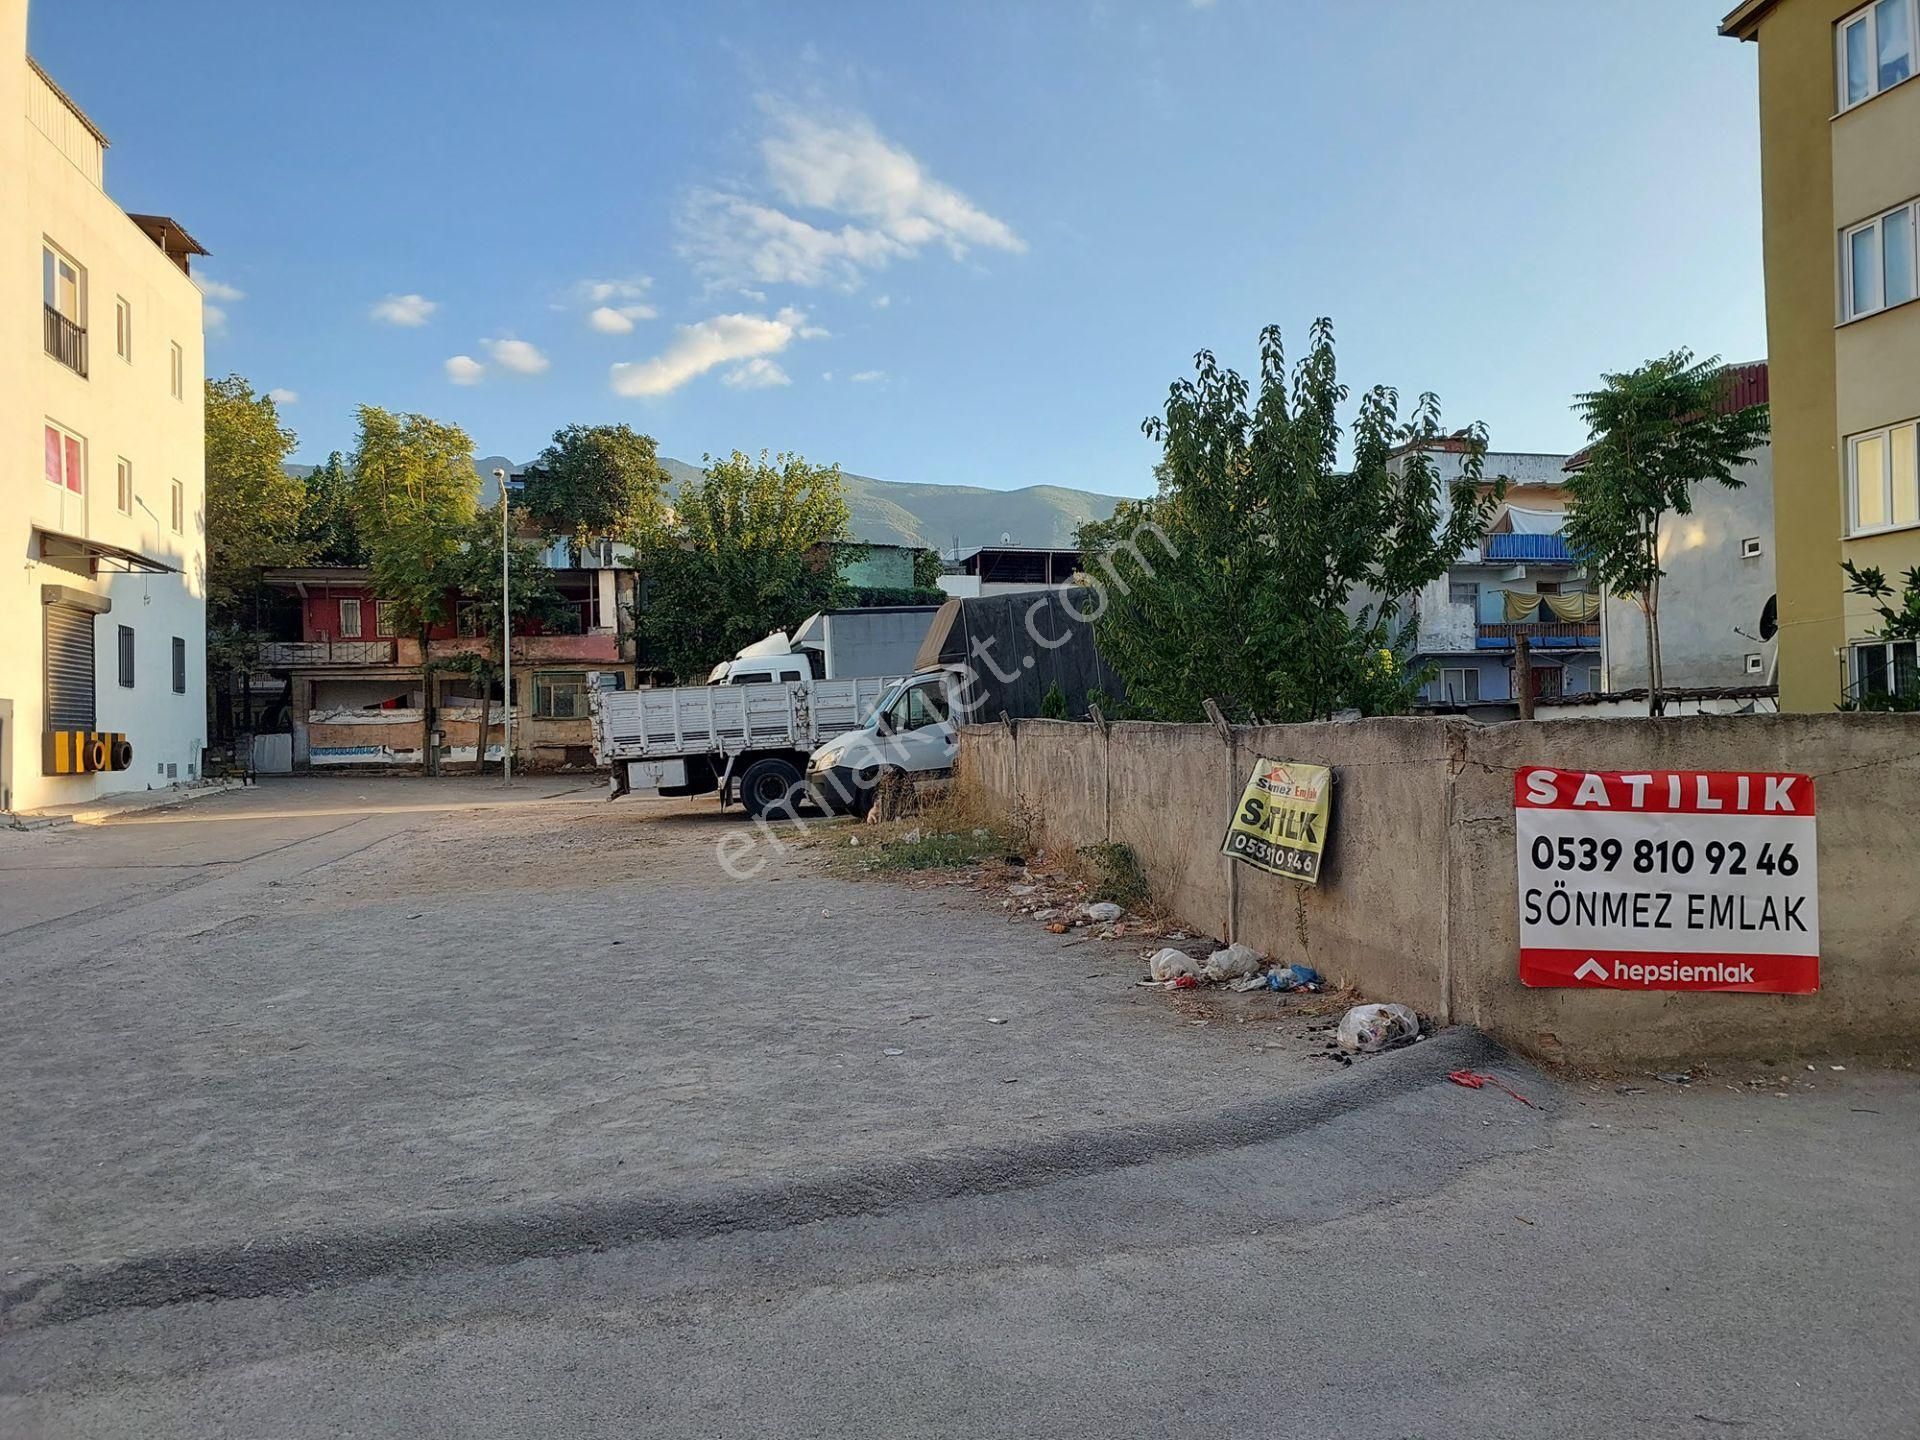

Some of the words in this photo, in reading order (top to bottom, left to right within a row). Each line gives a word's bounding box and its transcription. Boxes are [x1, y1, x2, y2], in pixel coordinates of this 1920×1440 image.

[1525, 770, 1797, 812] SATILIK
[1531, 835, 1623, 872] 0539
[1633, 838, 1695, 875] 810
[1524, 879, 1673, 930] SÖNMEZ
[1686, 893, 1809, 932] EMLAK
[1613, 959, 1755, 985] hepsiemlak
